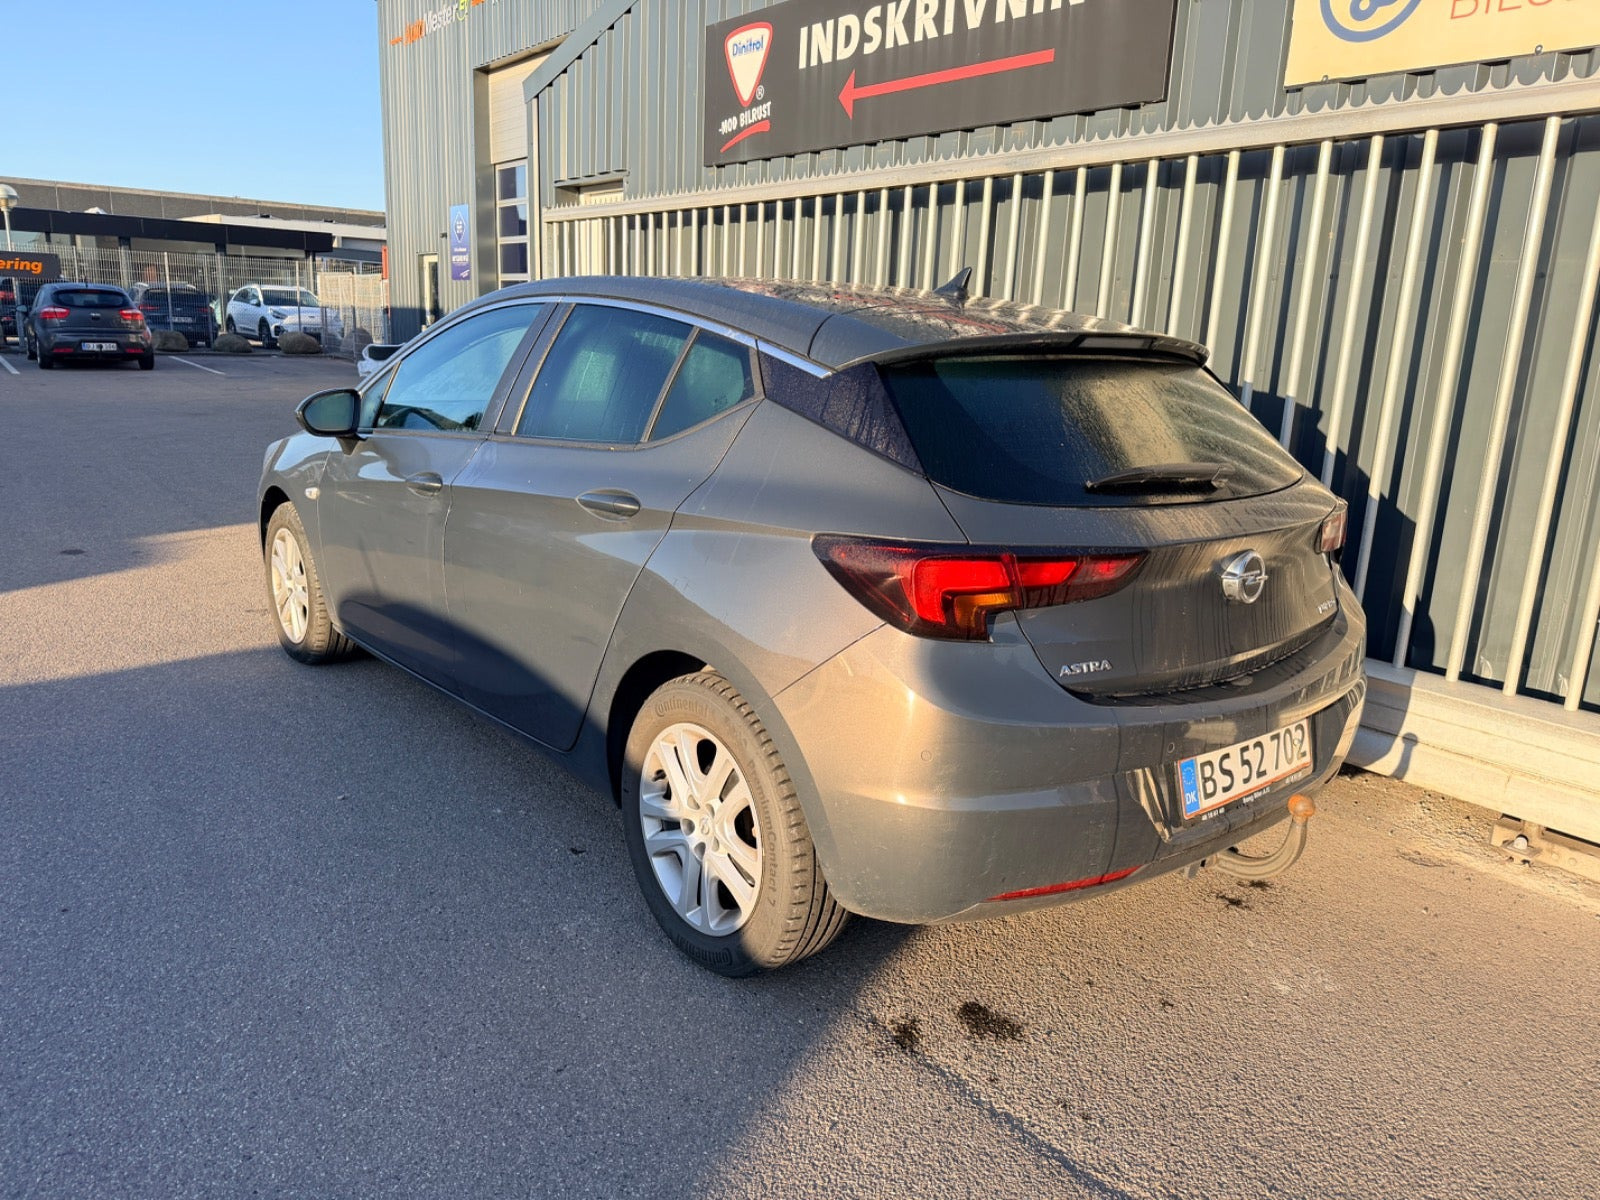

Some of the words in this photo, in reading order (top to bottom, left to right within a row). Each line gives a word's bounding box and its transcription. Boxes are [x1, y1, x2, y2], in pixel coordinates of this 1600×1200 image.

[732, 35, 764, 57] Dinitrol
[798, 0, 1086, 70] INDSKRIV
[739, 101, 772, 128] BILRUST
[1059, 659, 1113, 677] ASTRA
[1199, 752, 1235, 801] BS
[1239, 741, 1267, 785] 52
[1270, 723, 1307, 770] 702
[1185, 790, 1198, 805] DK
